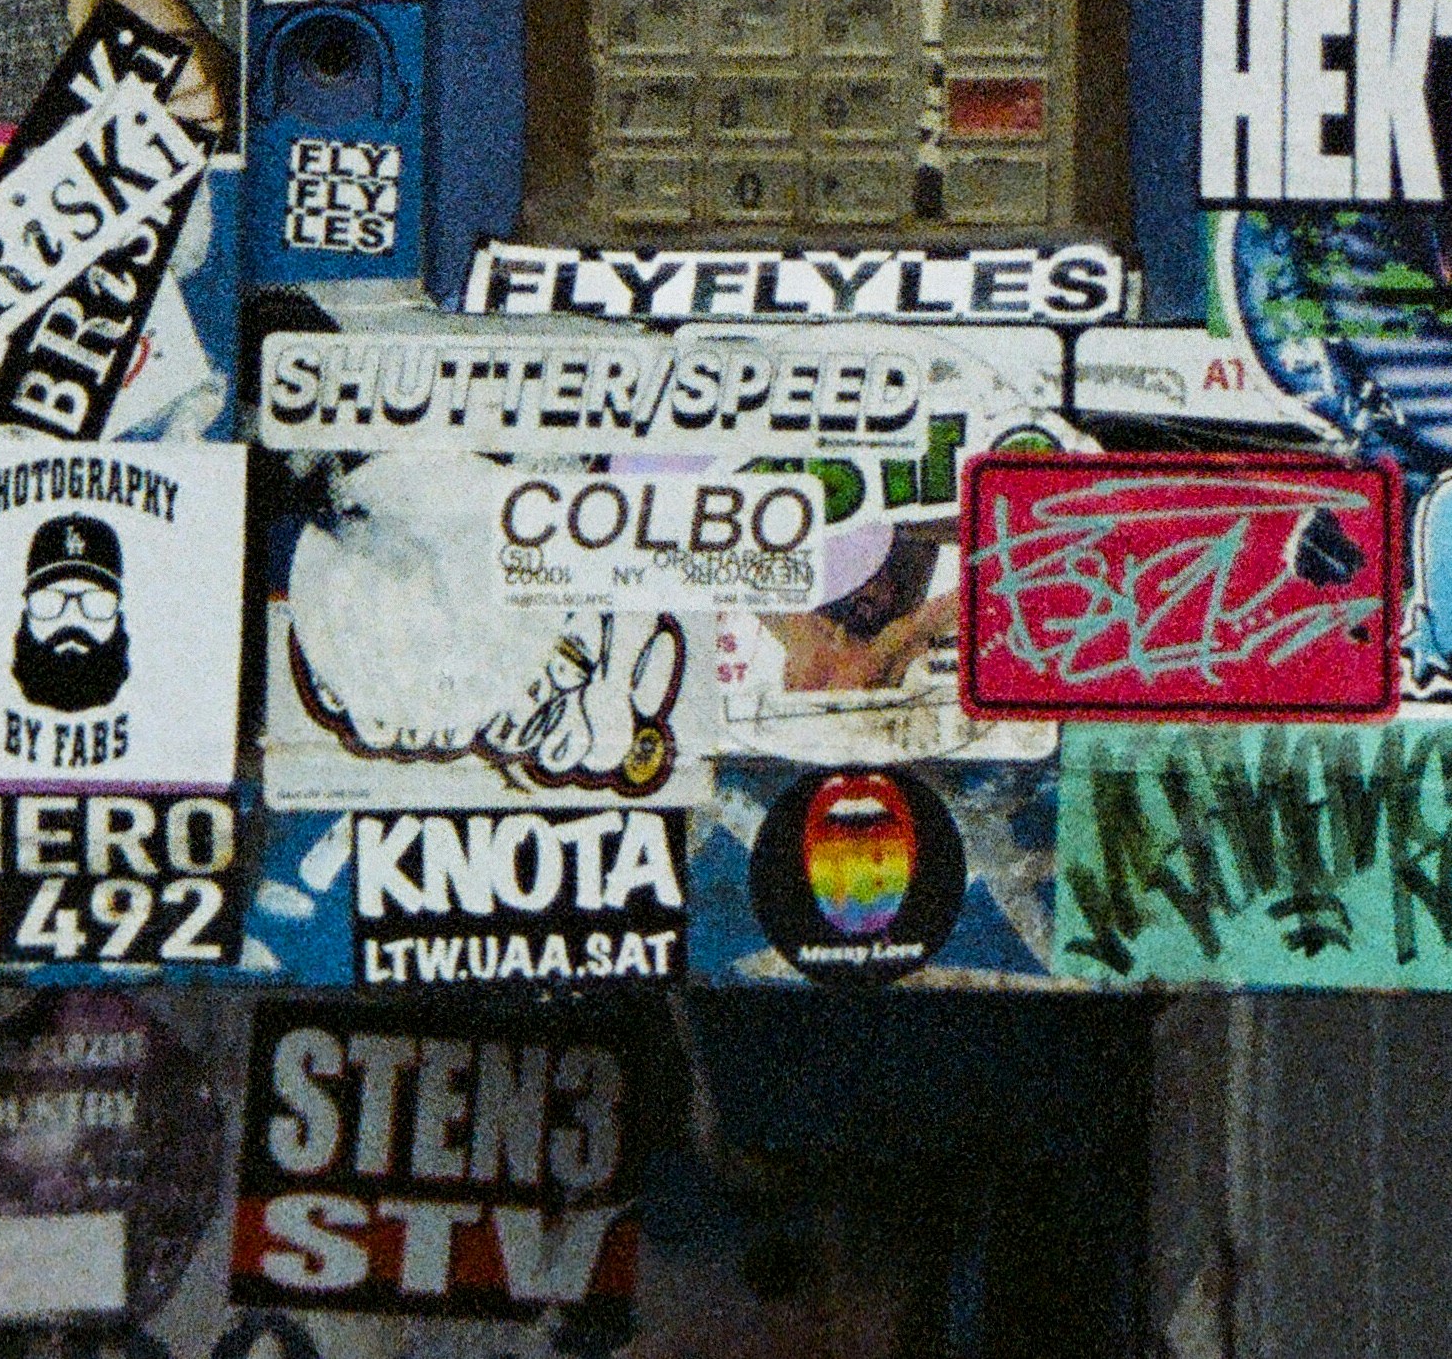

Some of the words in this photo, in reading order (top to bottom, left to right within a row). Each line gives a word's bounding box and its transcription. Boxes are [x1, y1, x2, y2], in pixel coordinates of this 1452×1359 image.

[294, 143, 396, 177] FLY
[292, 182, 395, 214] FLY
[288, 215, 392, 250] LES
[489, 246, 1112, 315] FLYFLYLES
[270, 342, 922, 435] SHUTTER/SPEED
[499, 480, 814, 555] COLBO
[3, 710, 38, 760] BY
[53, 713, 131, 768] FABS
[355, 810, 686, 920] KNOTA
[871, 939, 925, 963] Love
[266, 1024, 625, 1192] STEN3
